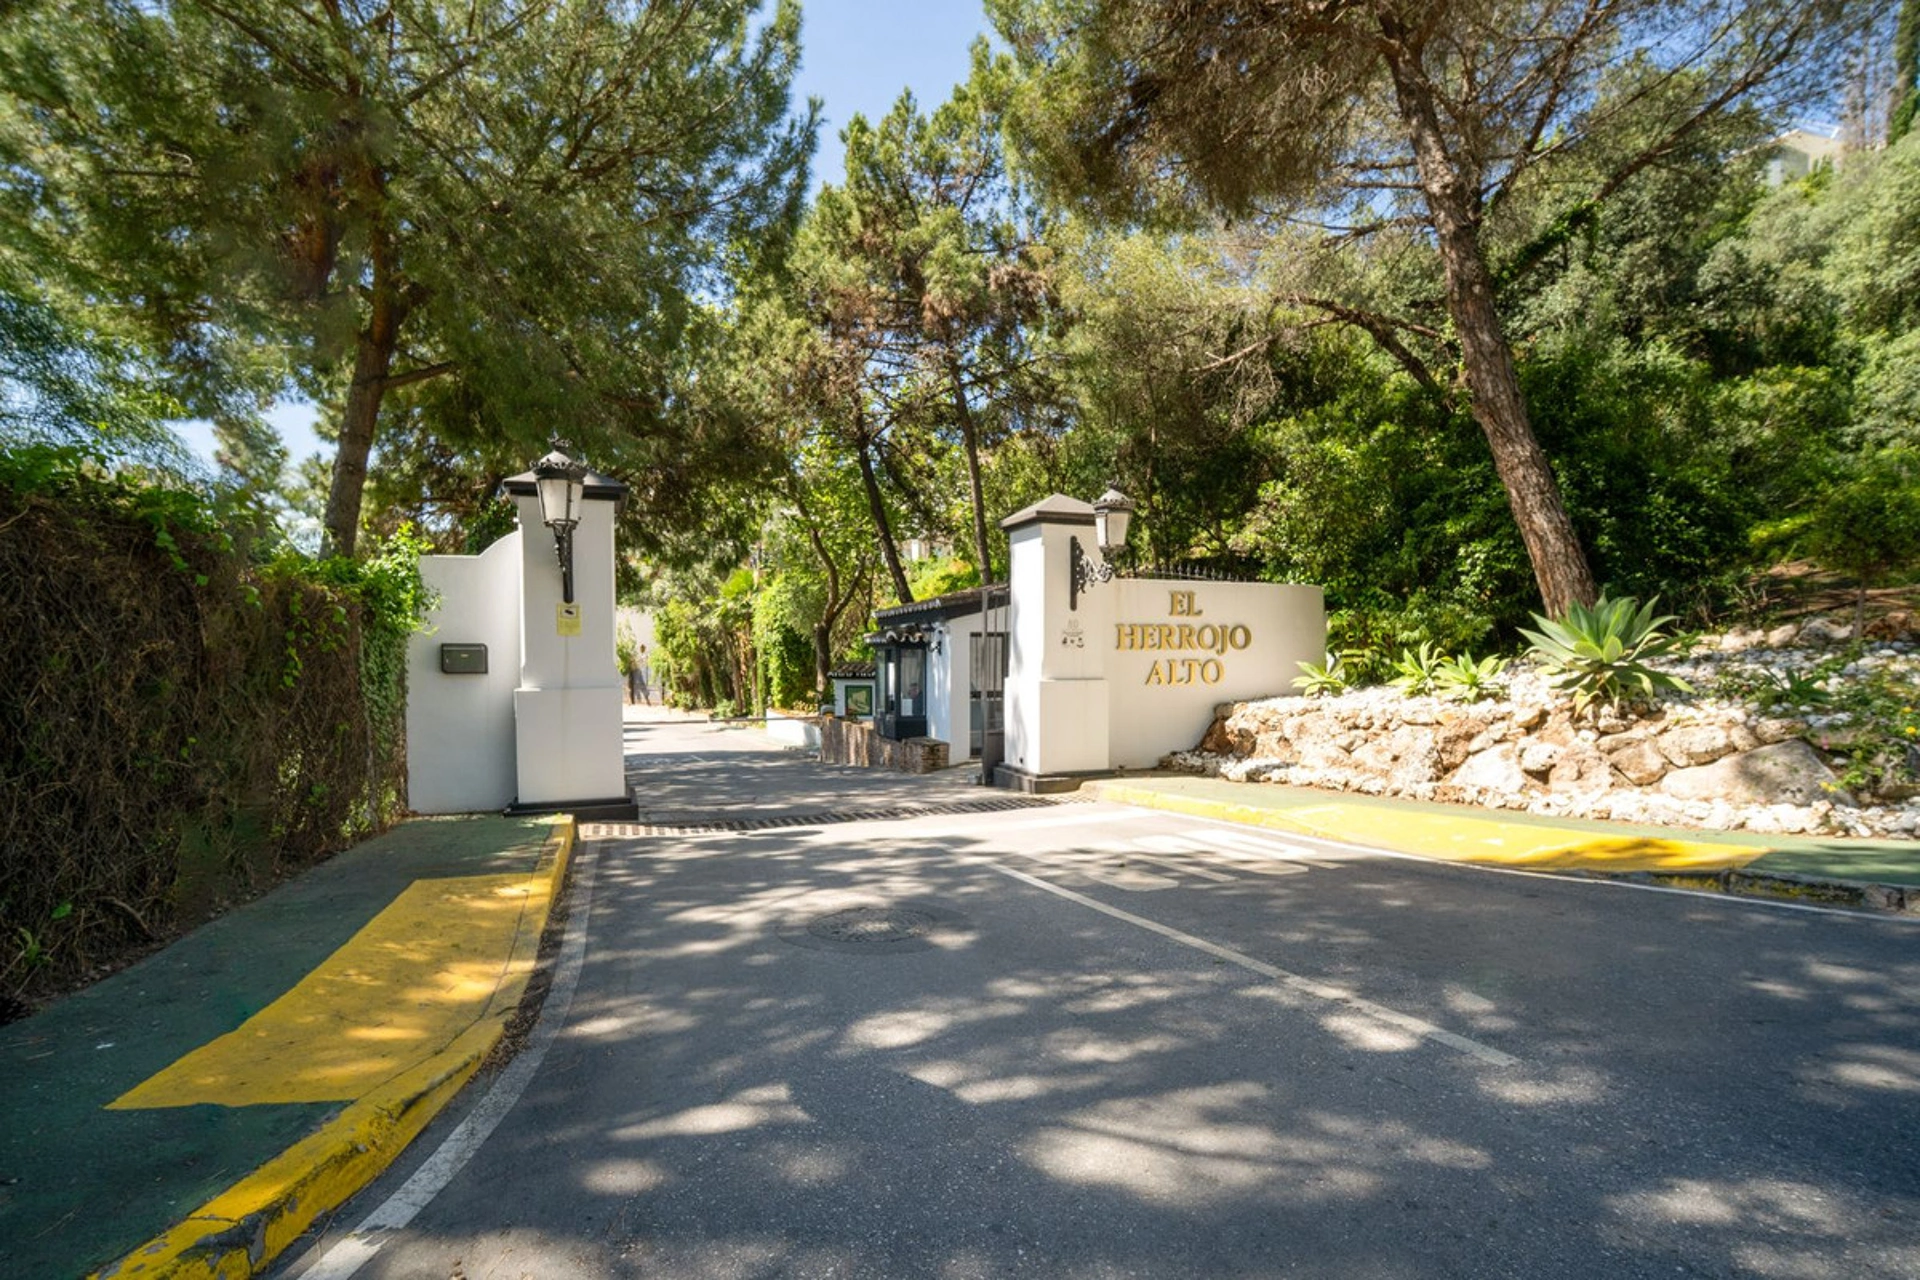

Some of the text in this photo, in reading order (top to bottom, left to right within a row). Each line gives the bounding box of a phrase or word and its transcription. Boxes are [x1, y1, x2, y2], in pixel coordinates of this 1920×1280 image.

[1168, 590, 1203, 616] EL
[1115, 624, 1252, 656] HERROJO
[1145, 659, 1225, 686] ALTO
